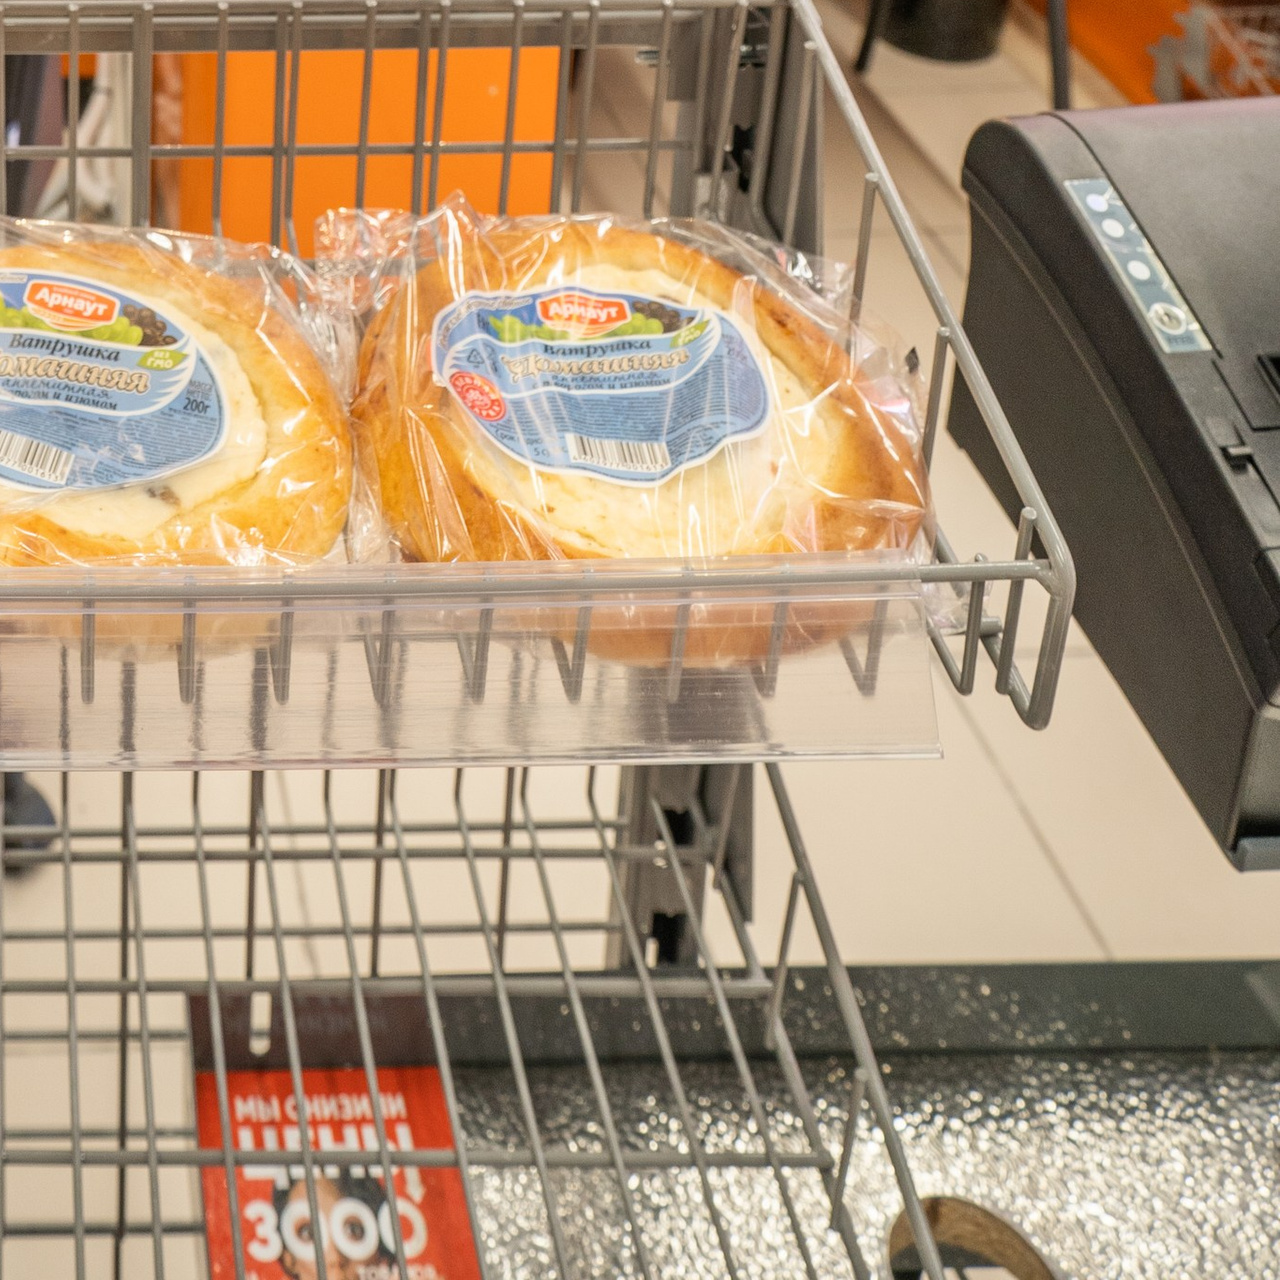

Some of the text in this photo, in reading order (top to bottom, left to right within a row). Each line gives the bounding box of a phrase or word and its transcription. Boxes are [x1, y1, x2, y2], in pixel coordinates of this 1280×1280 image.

[34, 287, 109, 317] Арнаут
[548, 302, 619, 323] Арнаут
[8, 332, 121, 363] Ватрушка
[542, 341, 652, 358] Ватрушка
[146, 355, 173, 370] ГМО
[182, 396, 210, 413] 200г
[233, 1093, 280, 1122] МЫ
[243, 1196, 428, 1263] 3000
